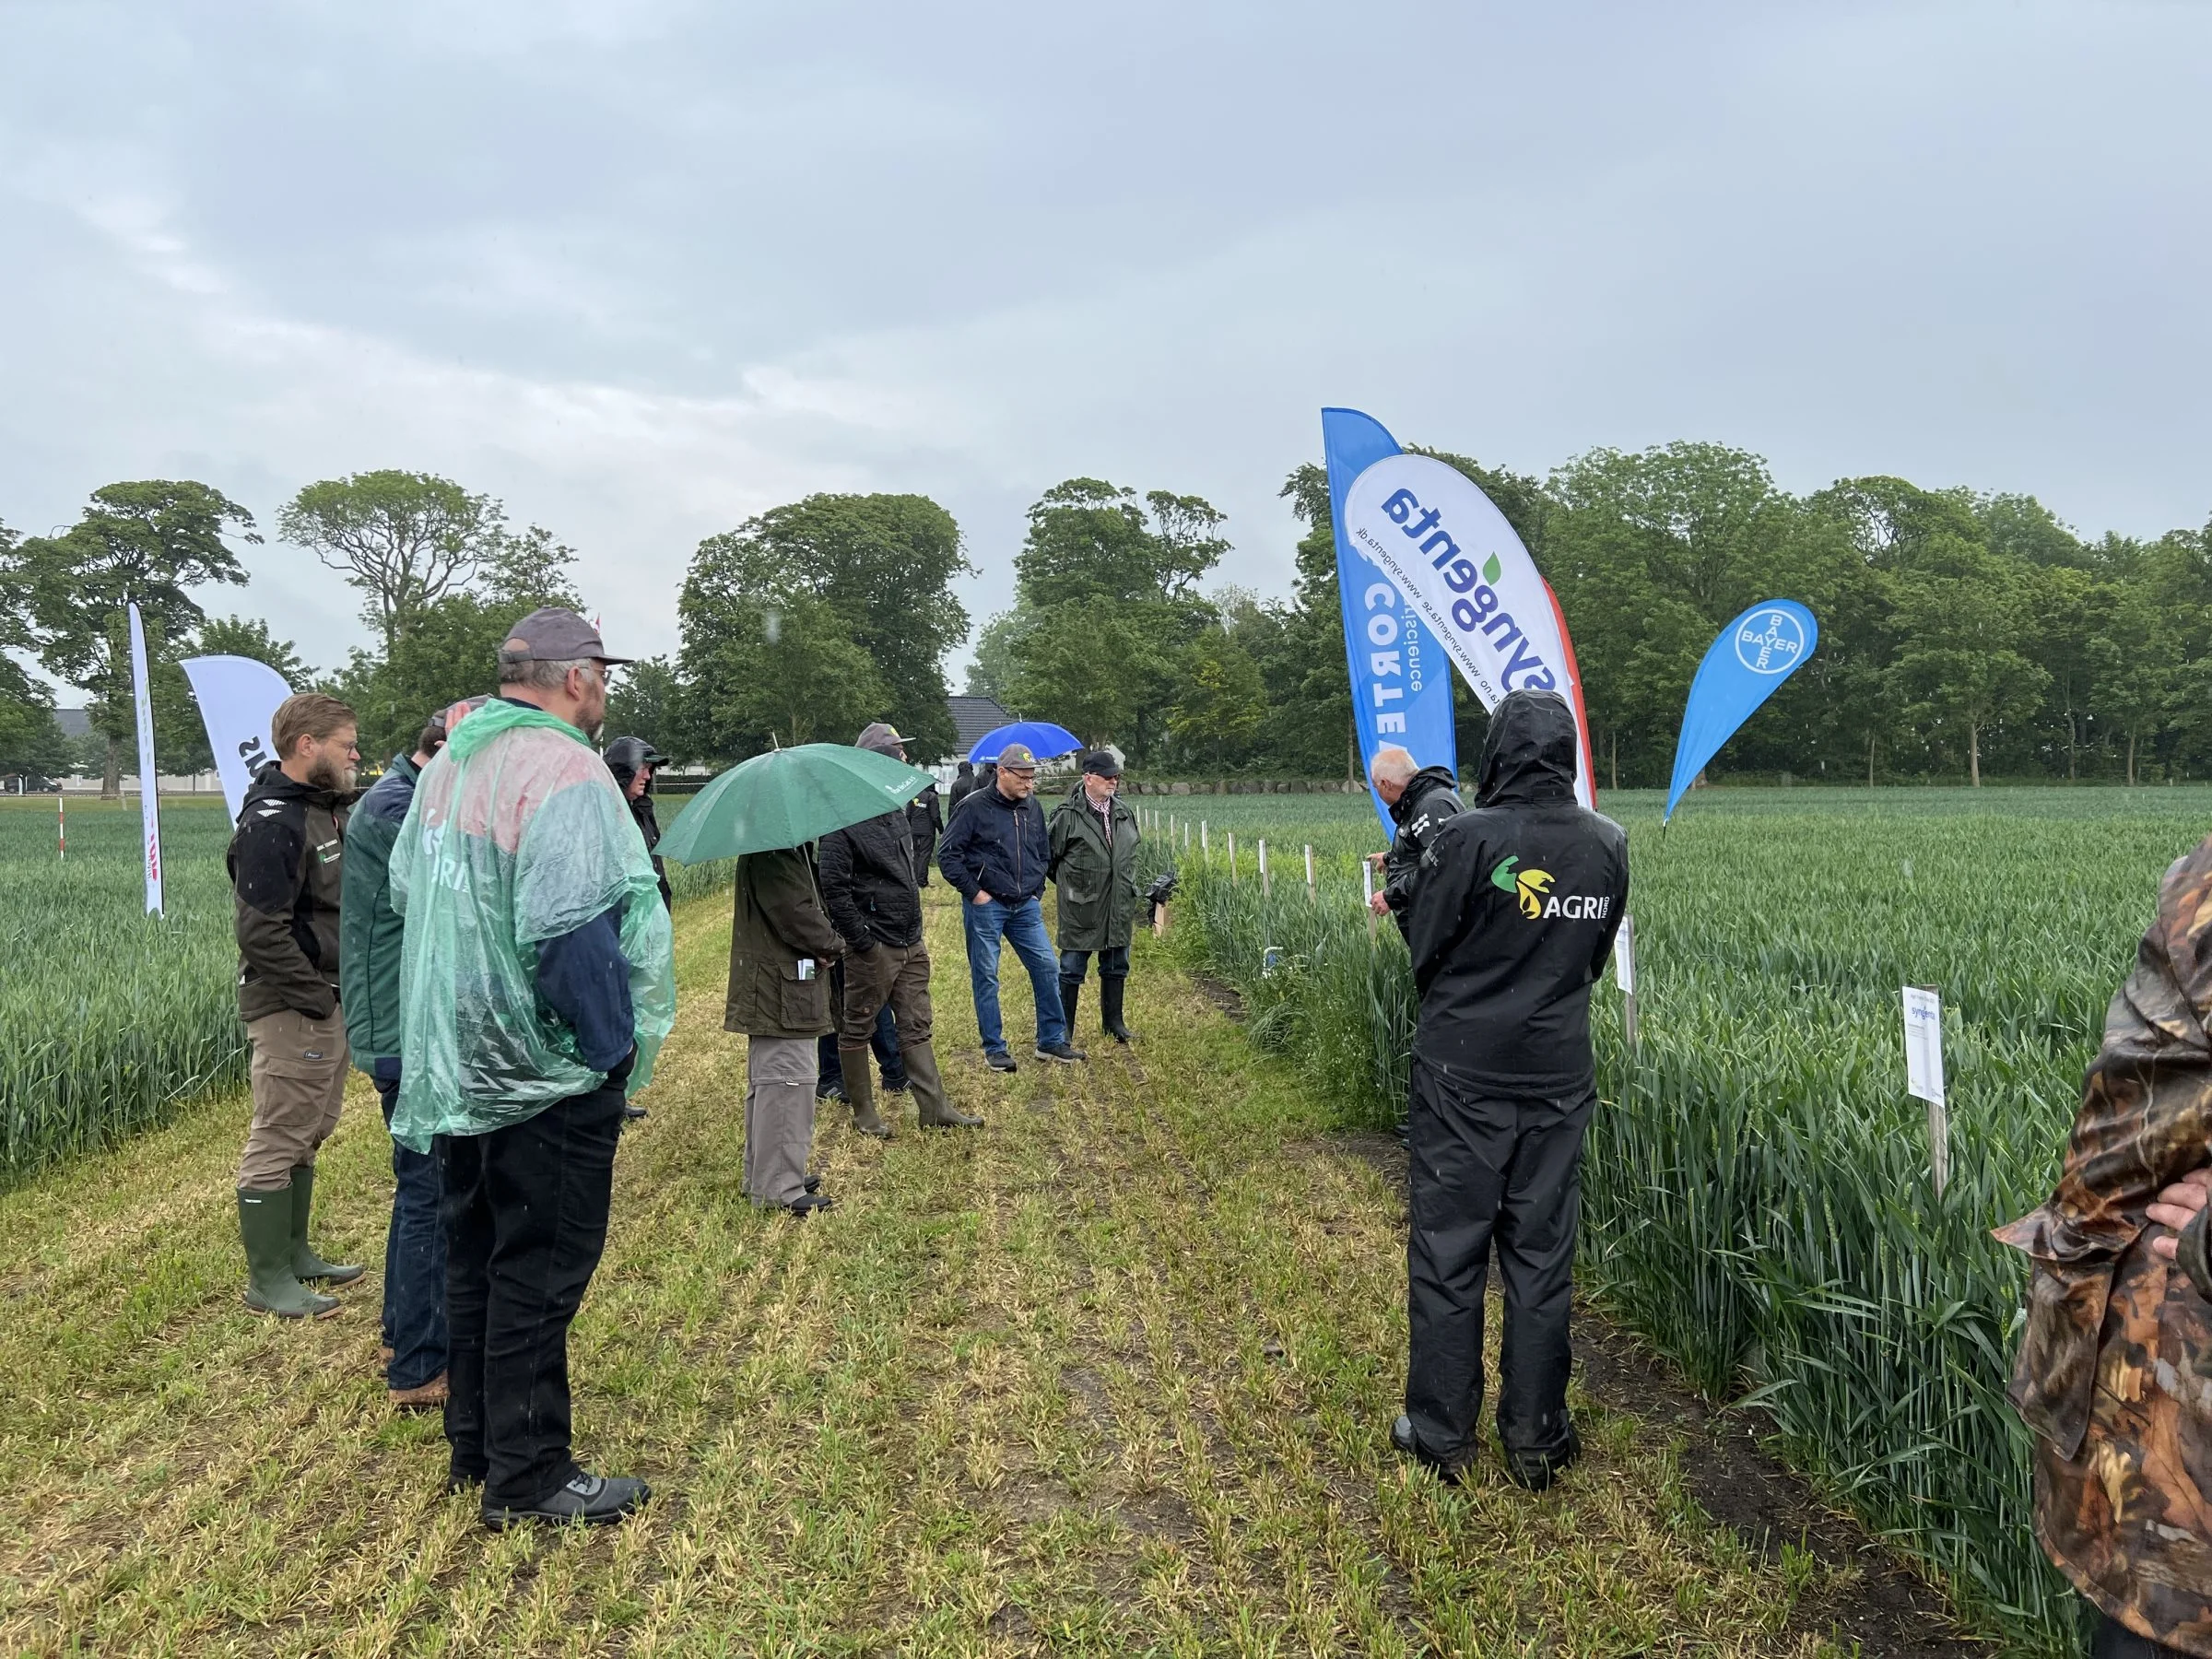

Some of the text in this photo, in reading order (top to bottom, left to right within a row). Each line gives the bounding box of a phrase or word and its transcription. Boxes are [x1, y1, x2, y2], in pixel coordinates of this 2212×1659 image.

[1741, 629, 1798, 653] BAYER
[1756, 614, 1783, 669] BAYER
[1543, 895, 1604, 920] AGRI
[1601, 896, 1610, 919] NORD
